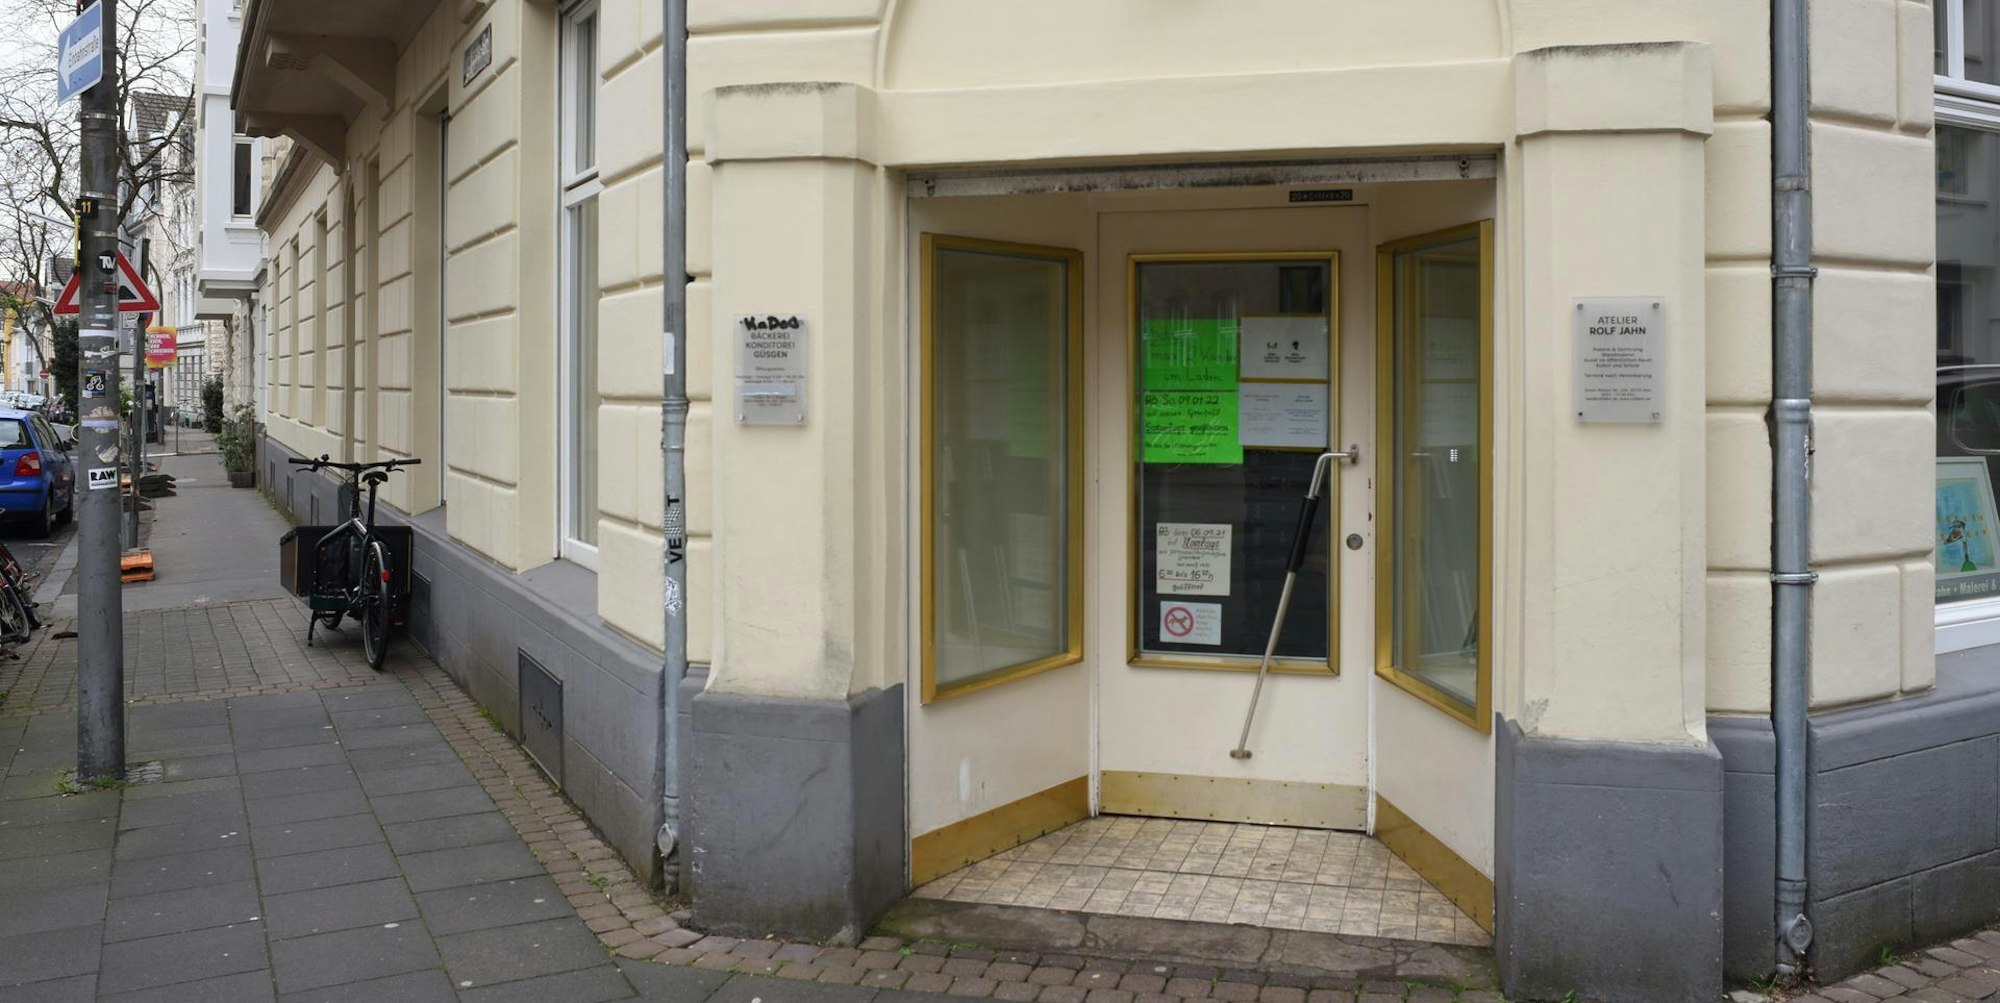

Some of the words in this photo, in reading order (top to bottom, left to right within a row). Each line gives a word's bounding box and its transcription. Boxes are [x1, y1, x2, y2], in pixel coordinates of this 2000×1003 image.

[81, 201, 92, 213] 11
[1597, 316, 1638, 324] ATELIER
[750, 330, 790, 340] BÄCKEREI
[1590, 327, 1616, 335] ROLF
[1619, 327, 1646, 335] JAHN
[745, 341, 795, 349] KONDITOREI
[753, 349, 788, 358] GÜSGEN
[91, 470, 116, 481] RAW
[1935, 585, 1951, 598] ahn
[1960, 580, 1988, 595] Malerei
